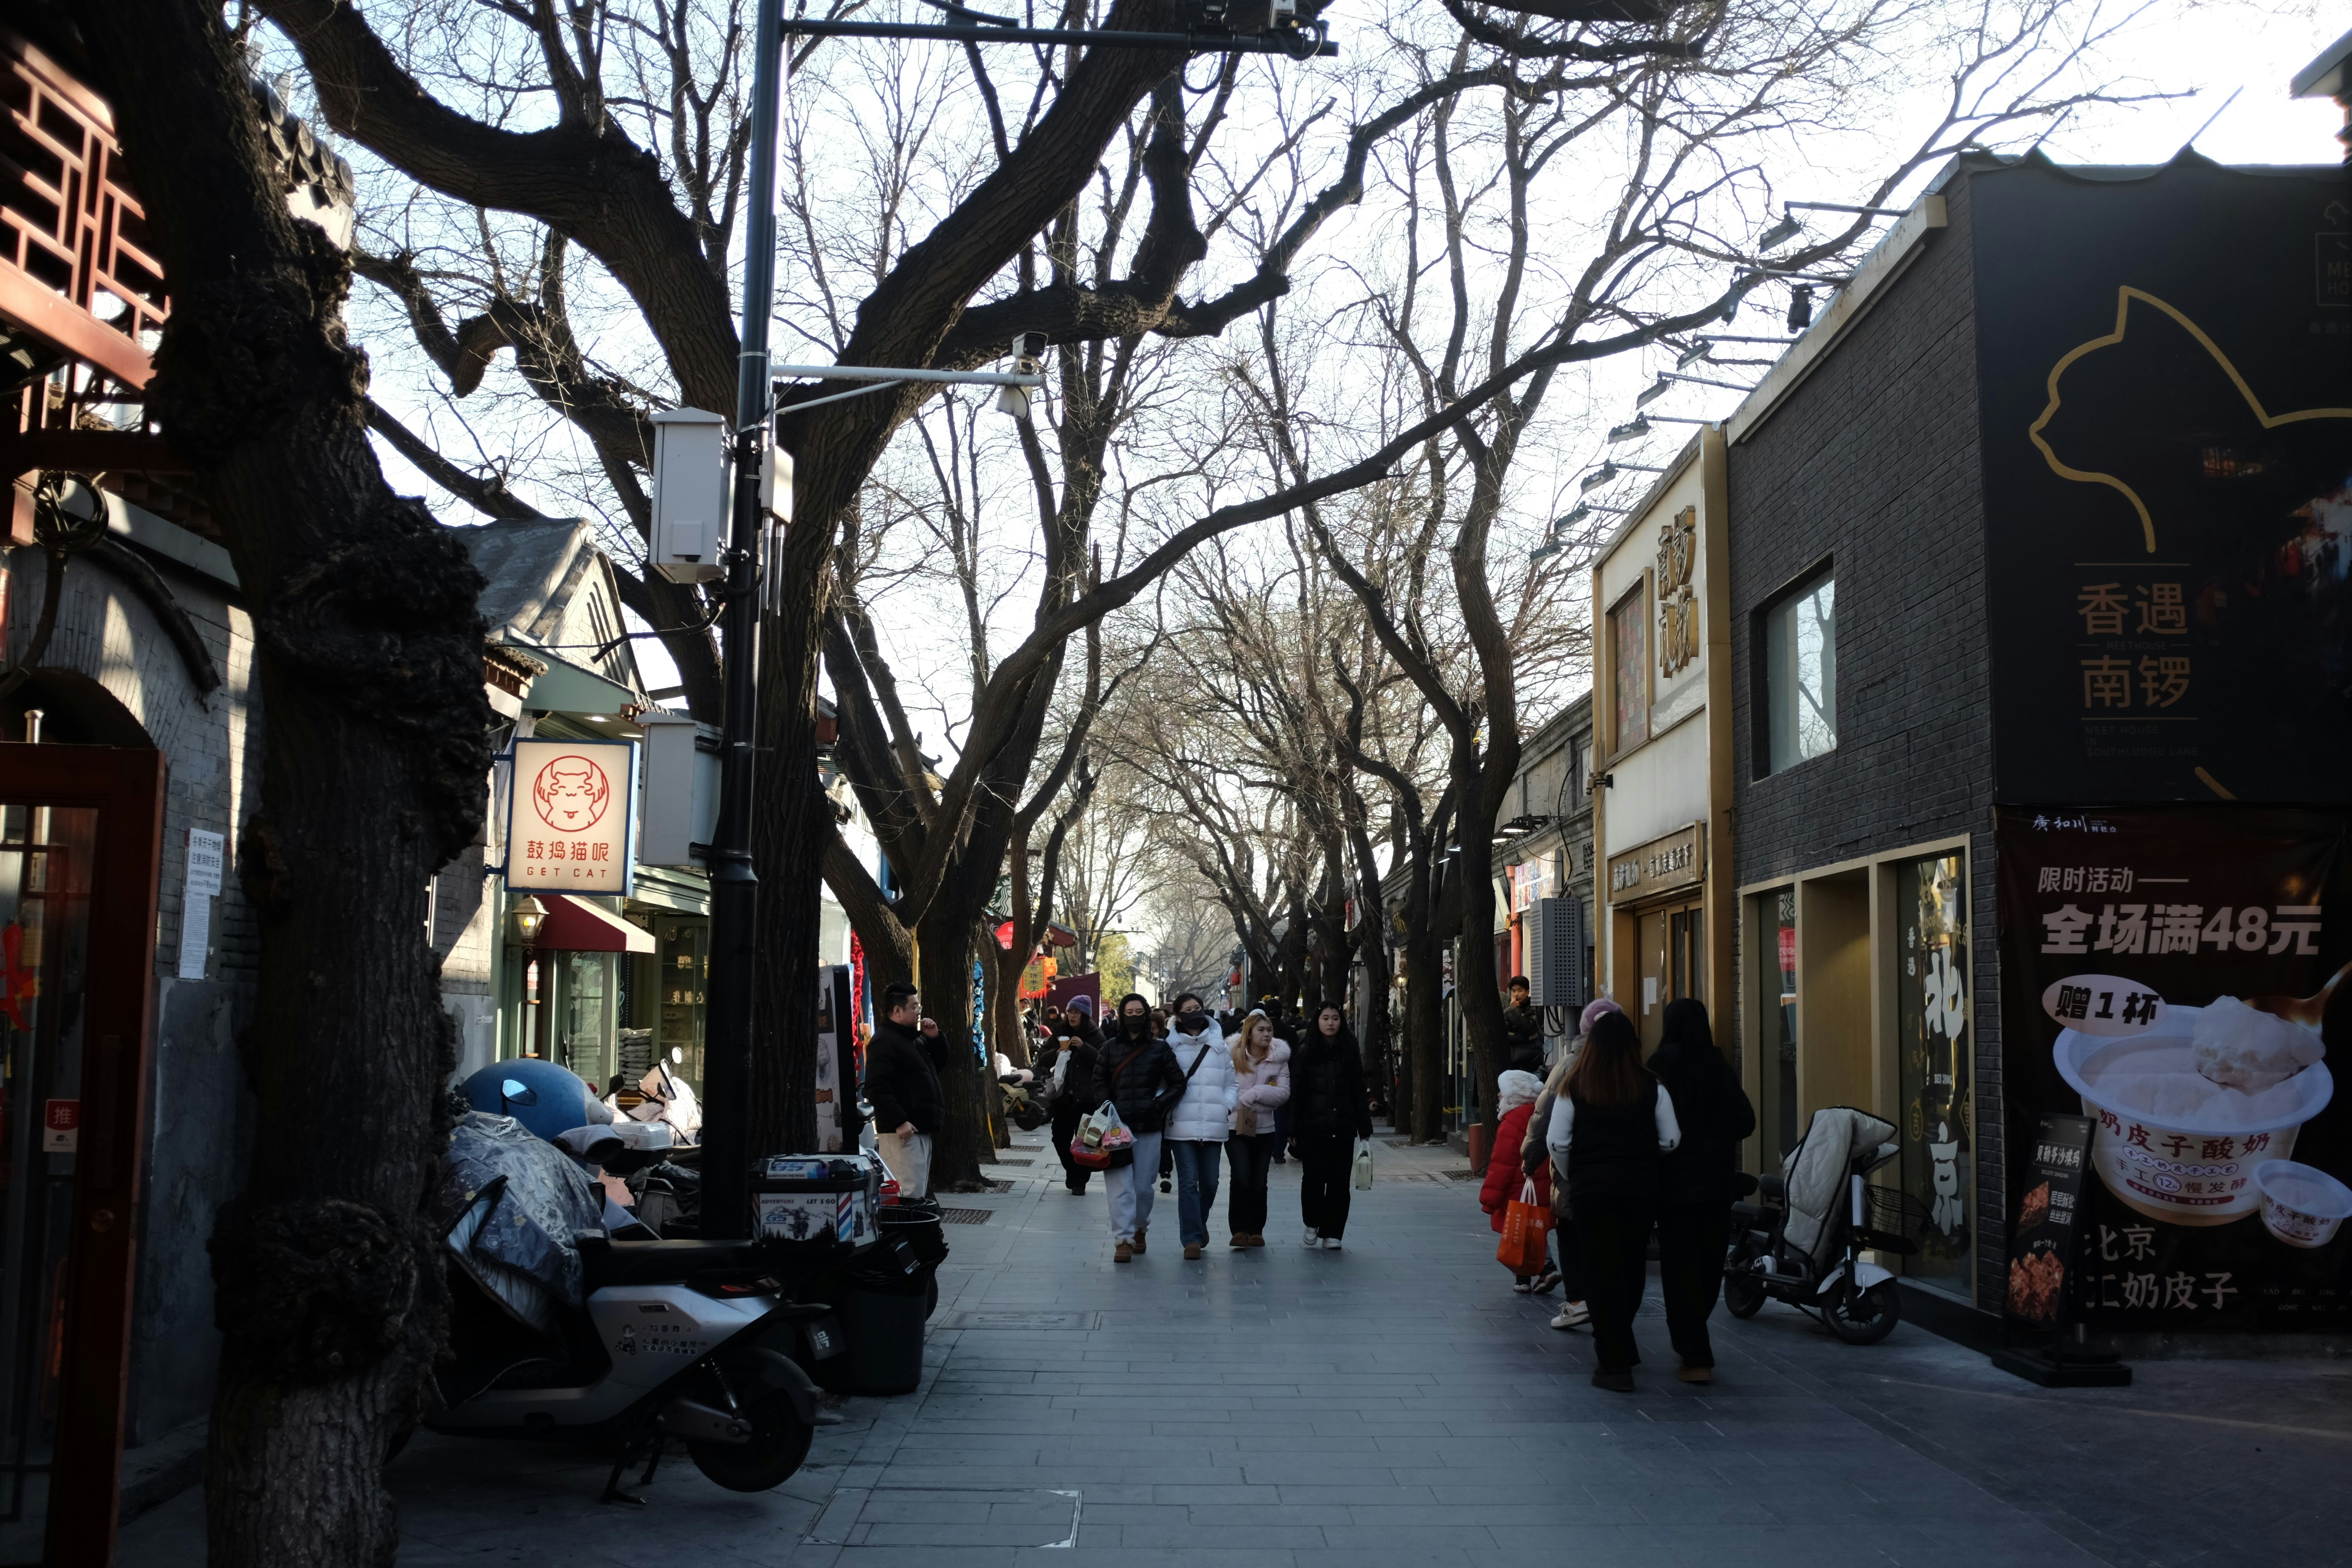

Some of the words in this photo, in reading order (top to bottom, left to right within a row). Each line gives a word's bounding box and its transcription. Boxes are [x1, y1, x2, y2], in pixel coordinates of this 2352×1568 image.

[2077, 582, 2188, 635] 香遇
[2081, 654, 2191, 708] 南锣
[2085, 726, 2115, 735] MEET
[2120, 725, 2159, 734] HOUSE
[2169, 747, 2198, 756] LANE
[527, 840, 609, 862] 鼓捣猫呢
[527, 867, 560, 876] GET
[574, 869, 606, 878] CAT
[2038, 867, 2133, 893] 限时活动
[2041, 904, 2322, 956] 全场满48元
[54, 1107, 72, 1124] 推
[2099, 1108, 2270, 1160] 奶皮子酸奶
[2035, 1145, 2080, 1168] 贝勒爷沙琪玛
[2116, 1156, 2149, 1183] 手工
[2185, 1176, 2248, 1194] 慢发酵
[2050, 1190, 2075, 1210] 层层酥松
[2266, 1196, 2330, 1225] 奶皮子酸奶
